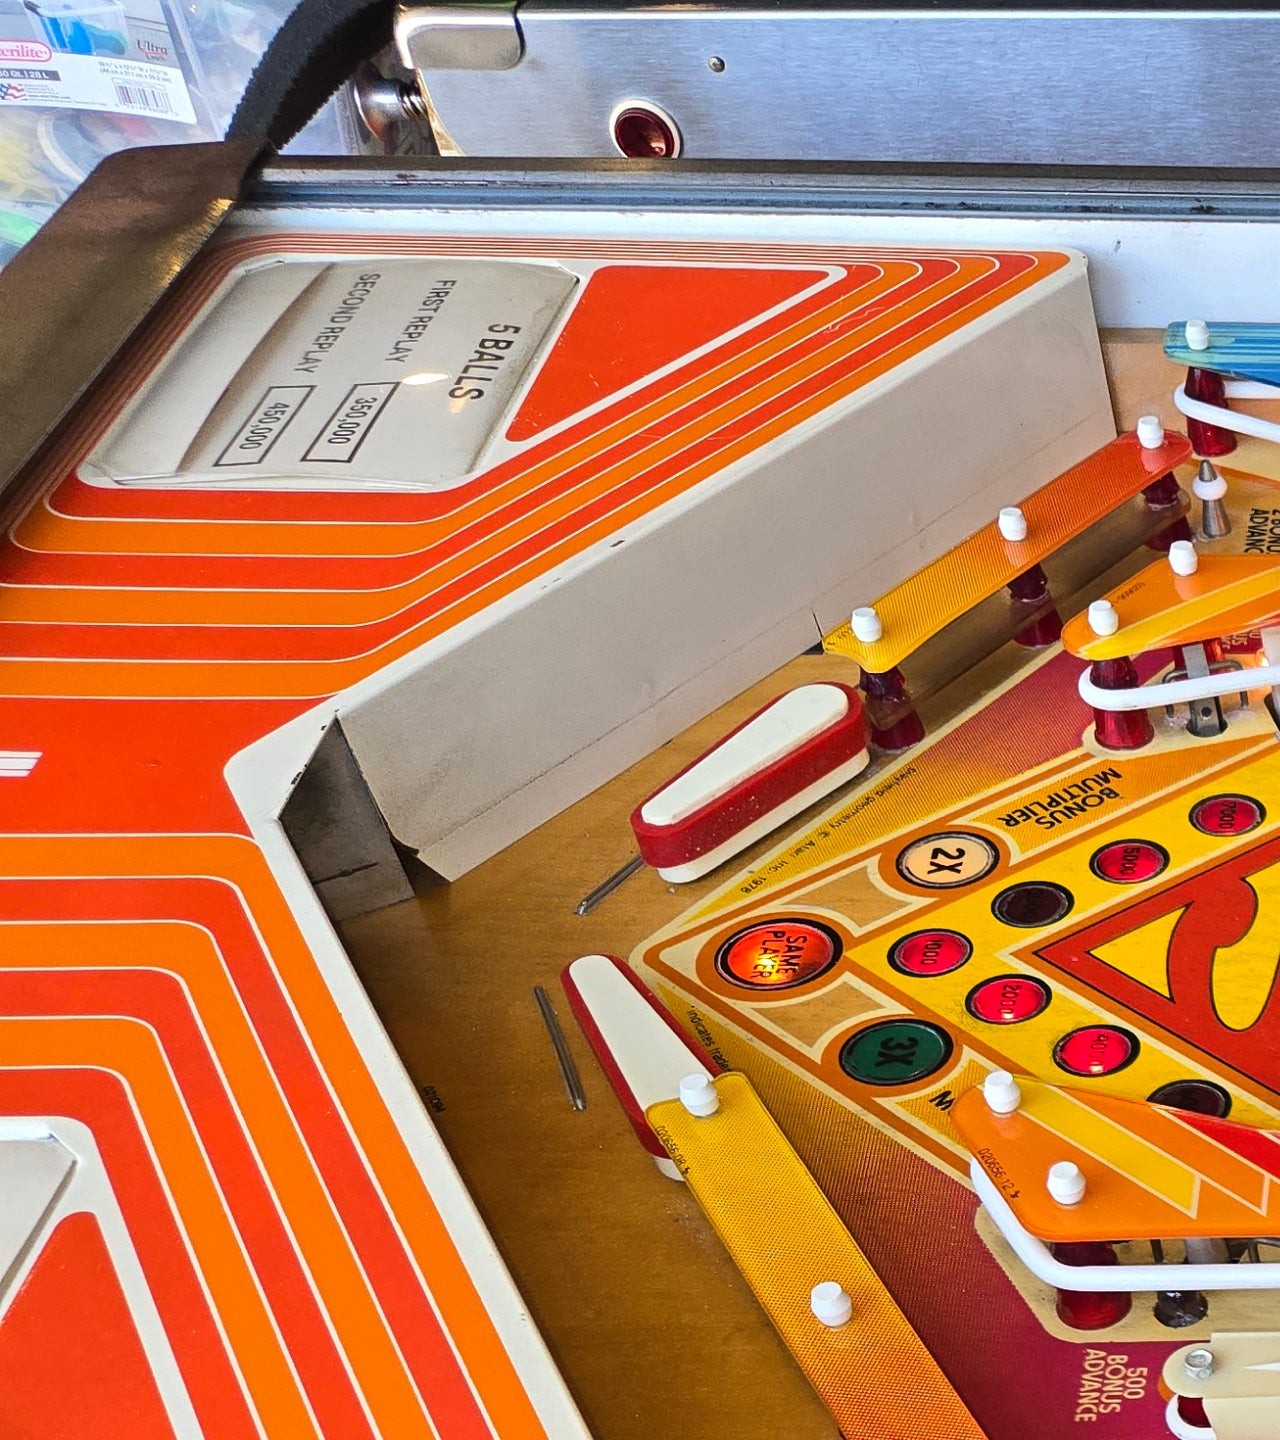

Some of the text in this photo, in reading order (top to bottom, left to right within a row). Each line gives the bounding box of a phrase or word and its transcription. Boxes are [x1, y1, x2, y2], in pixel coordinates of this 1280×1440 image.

[137, 39, 168, 54] Ultra
[239, 272, 381, 450] SECOND REPLAY 450,000
[327, 279, 457, 445] FIRST REPLAY 350,000
[448, 323, 521, 400] 5 BALLS
[1244, 508, 1270, 553] ADVANC
[997, 767, 1123, 828] MULTIPLIER
[1034, 787, 1121, 830] BONUS
[927, 847, 966, 875] 2X
[741, 876, 767, 894] 1978
[750, 930, 787, 979] PLAYER
[776, 935, 808, 978] SAME
[920, 939, 943, 965] 1000
[874, 1035, 919, 1069] 3X
[1074, 1348, 1106, 1423] ADVANCE
[1098, 1354, 1128, 1413] BONUS
[1123, 1367, 1148, 1400] 500
